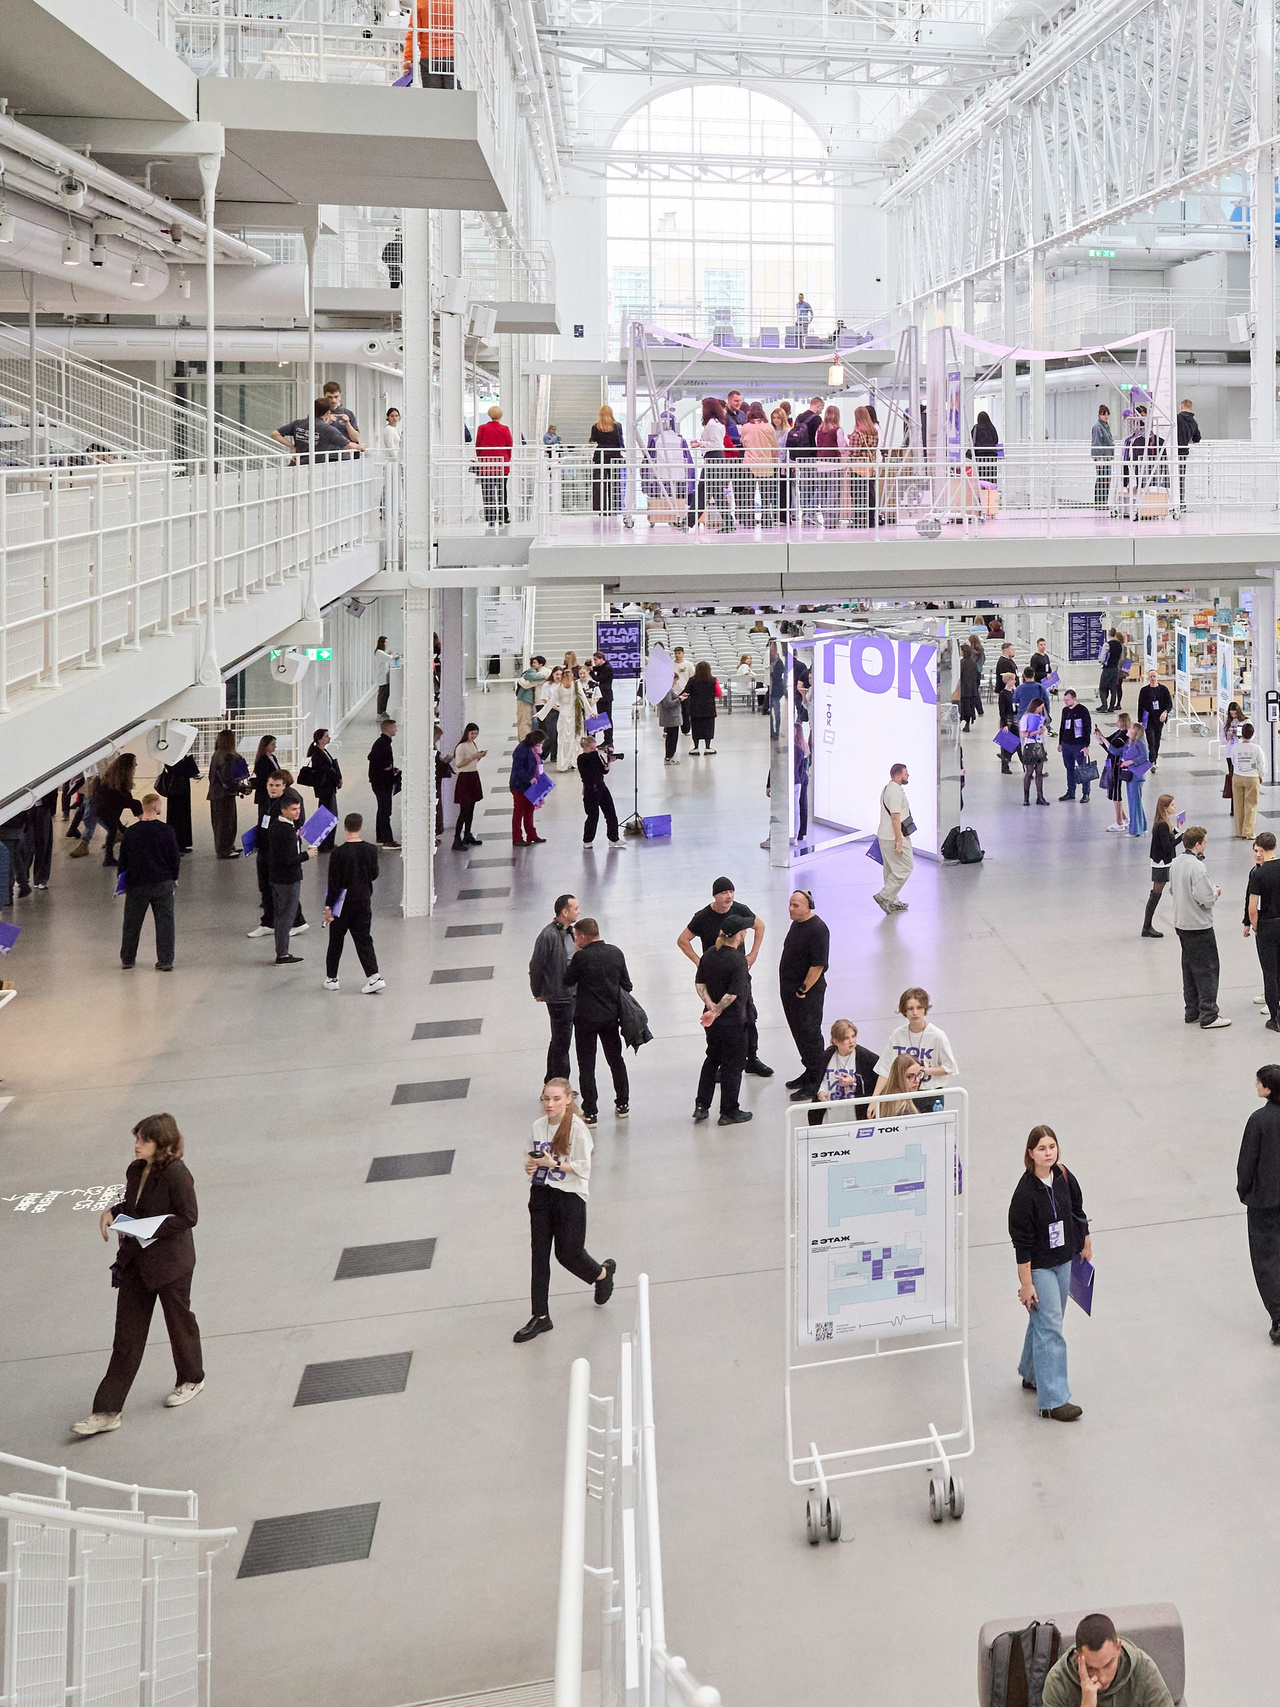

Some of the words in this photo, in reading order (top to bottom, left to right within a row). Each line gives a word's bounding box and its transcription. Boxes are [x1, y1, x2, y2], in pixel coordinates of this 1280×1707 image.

[598, 628, 639, 636] ГЛАВ
[823, 636, 938, 705] ТОК
[893, 1046, 934, 1060] ТОК
[877, 1126, 900, 1134] ТОК
[820, 1149, 850, 1158] ЭТАЖ
[820, 1235, 850, 1244] ЭТАЖ
